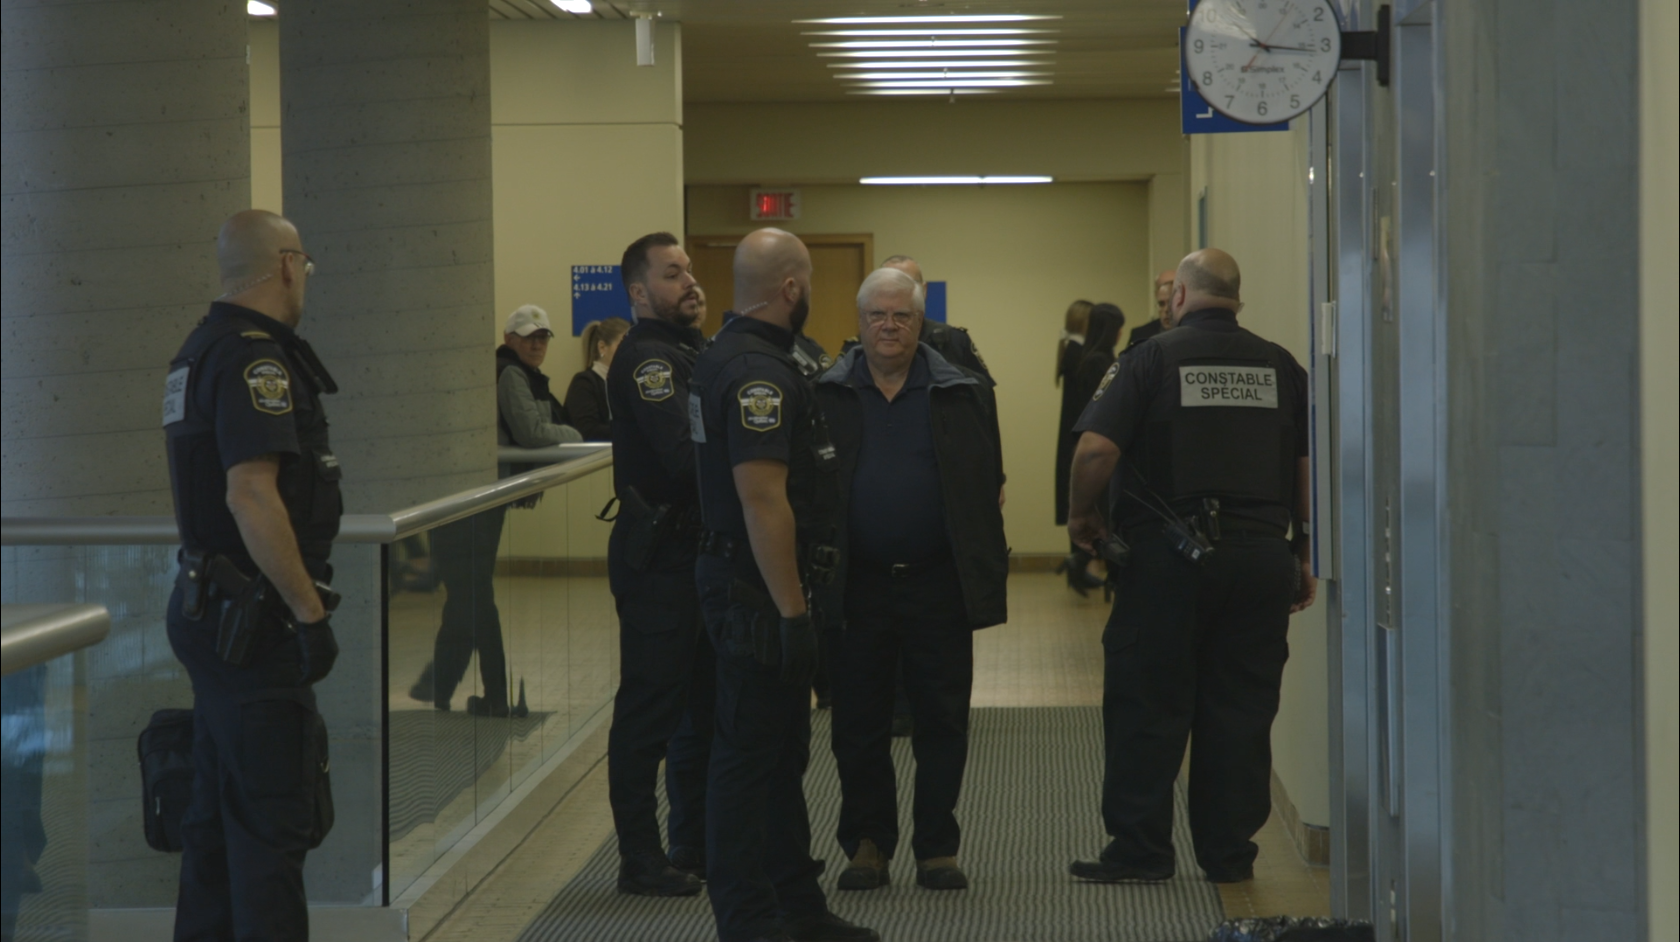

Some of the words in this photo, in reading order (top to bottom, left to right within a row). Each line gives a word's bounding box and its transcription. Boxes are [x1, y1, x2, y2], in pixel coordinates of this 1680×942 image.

[1199, 8, 1216, 23] 10
[1314, 7, 1324, 21] 2
[1194, 39, 1204, 54] 9
[1320, 38, 1331, 52] 3
[1202, 71, 1213, 86] 8
[1312, 70, 1322, 84] 4
[1224, 95, 1235, 109] 7
[1257, 101, 1268, 116] 6
[1289, 94, 1300, 109] 5
[573, 266, 589, 274] 4.01
[596, 266, 613, 274] 4.12
[573, 283, 590, 291] 4.13
[597, 283, 612, 291] 4.21
[1185, 372, 1273, 387] CONSTABLE
